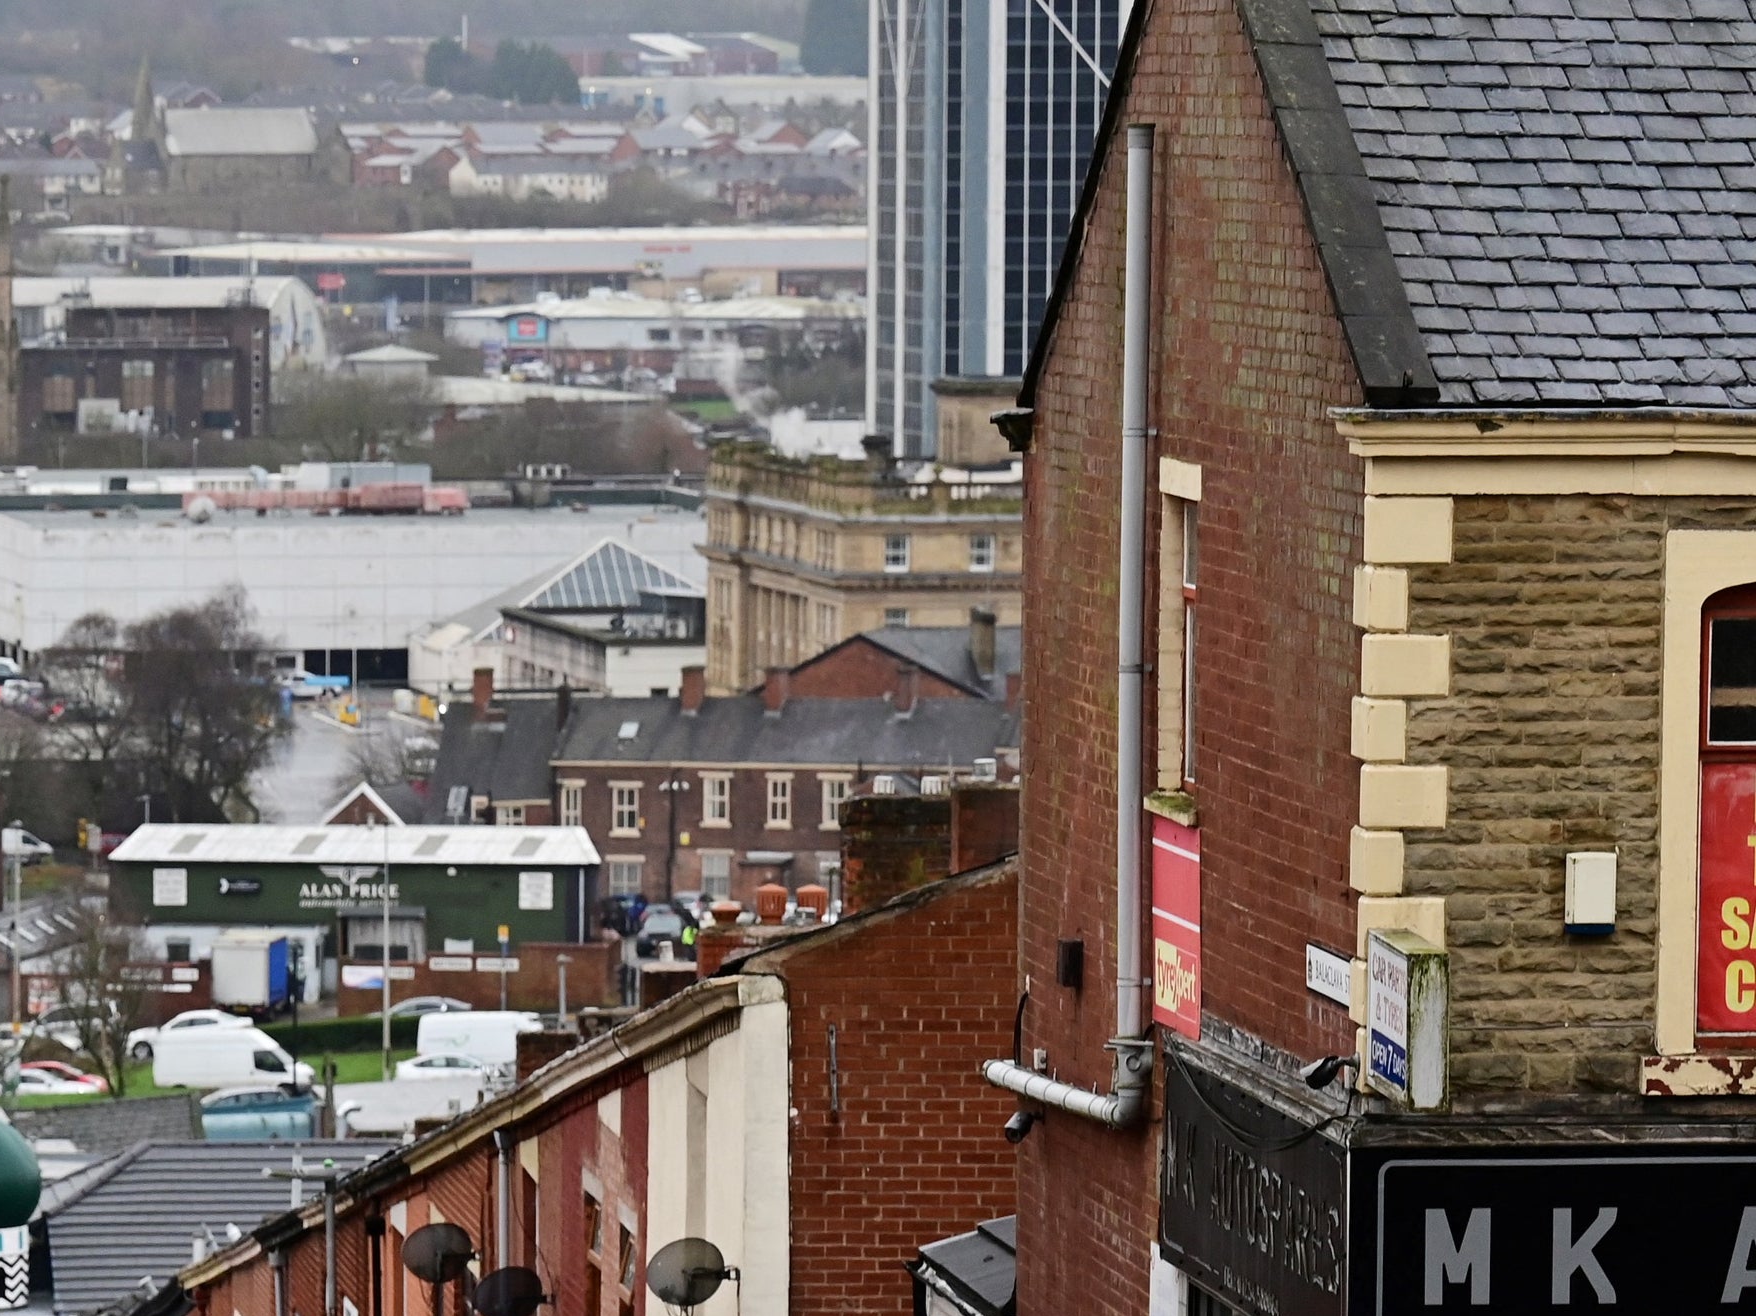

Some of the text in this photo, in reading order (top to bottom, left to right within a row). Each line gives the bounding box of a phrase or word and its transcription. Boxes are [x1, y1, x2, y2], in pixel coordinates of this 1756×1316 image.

[299, 883, 400, 899] ALAN PRICE
[1315, 960, 1343, 991] BALACLAVA
[1372, 952, 1387, 986] CAR
[1384, 1000, 1404, 1036] TYRES
[1372, 1040, 1406, 1078] OPEN 7 DAYS
